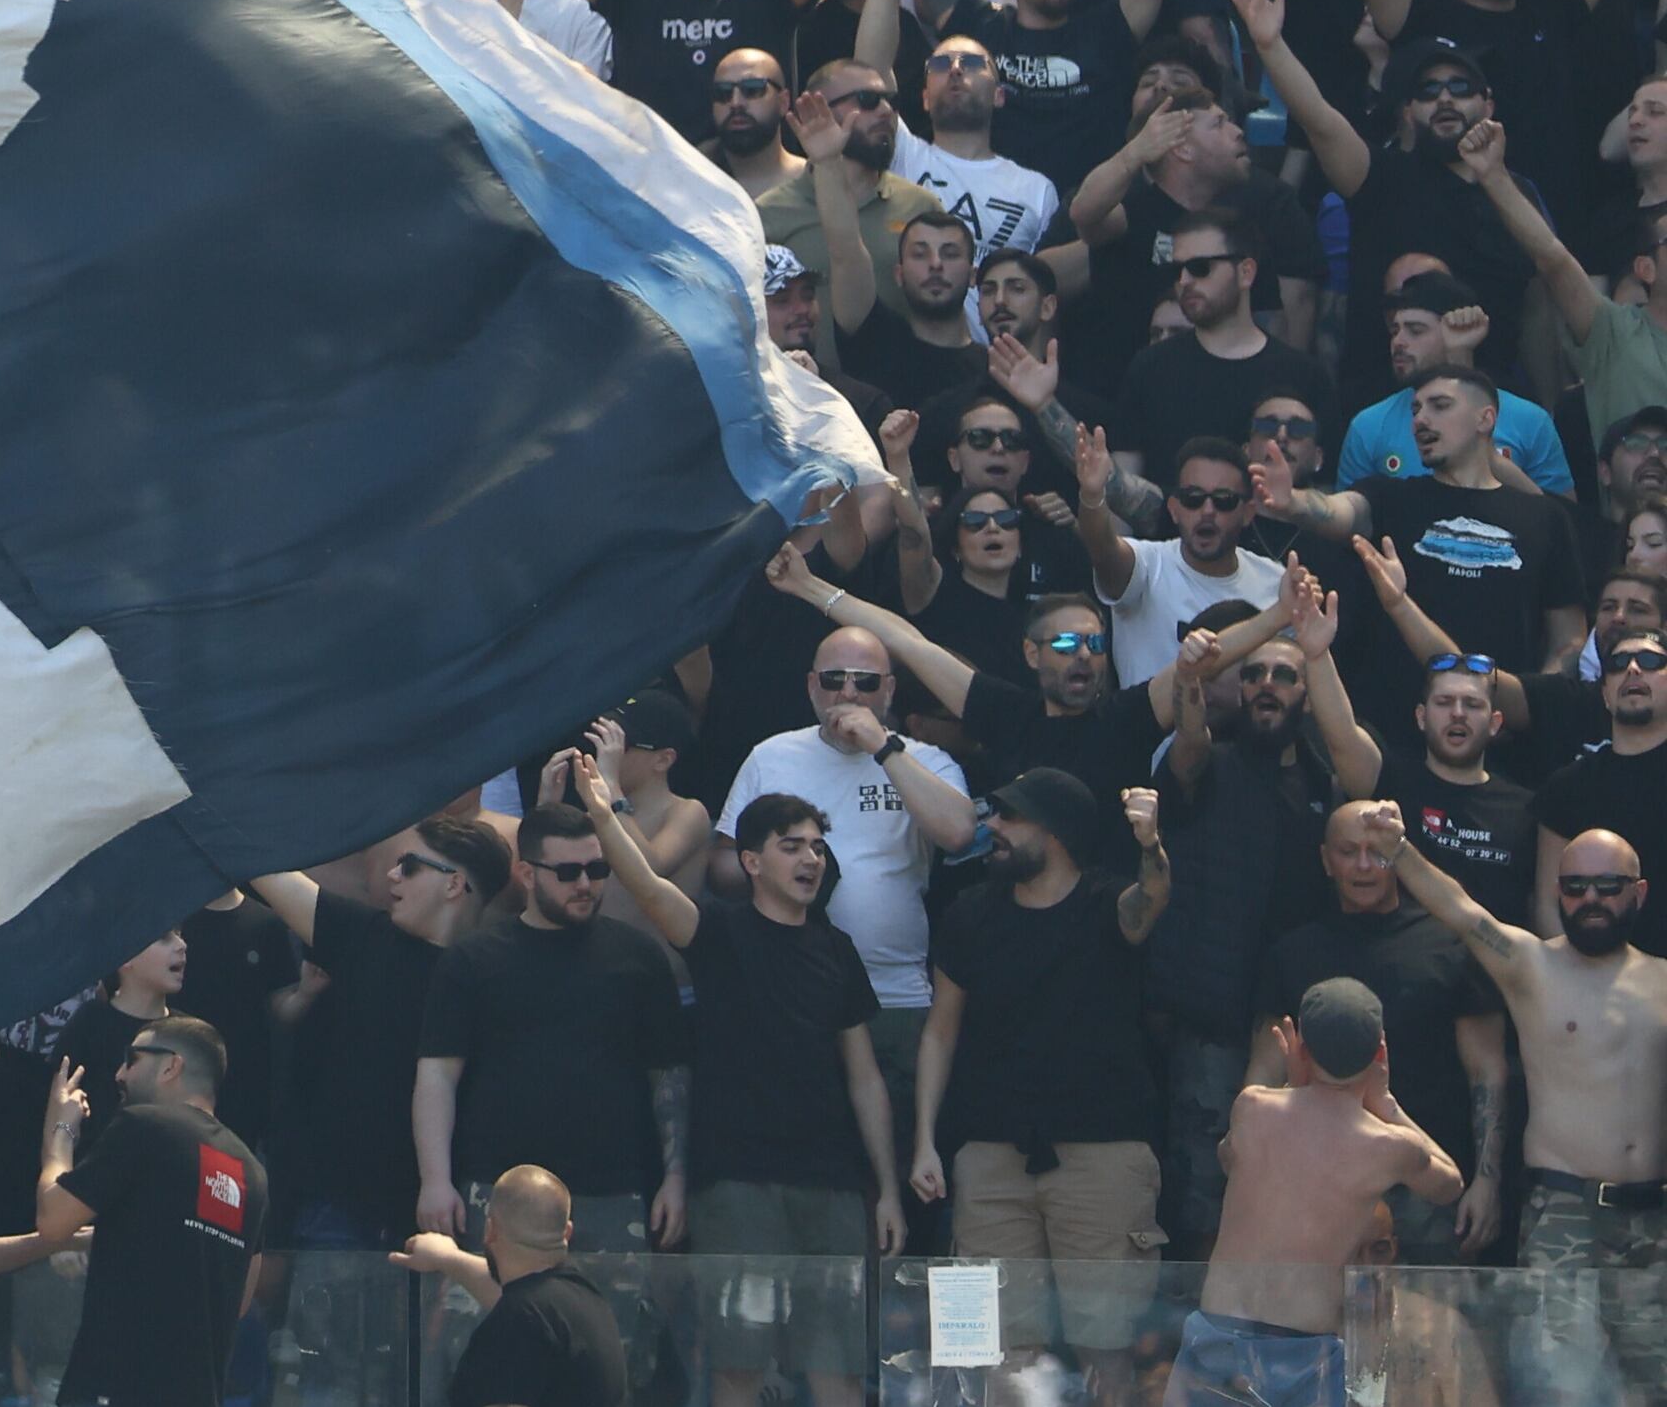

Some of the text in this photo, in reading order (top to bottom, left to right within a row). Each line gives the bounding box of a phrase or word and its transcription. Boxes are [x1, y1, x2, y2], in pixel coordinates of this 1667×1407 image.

[661, 17, 734, 42] merc
[1447, 565, 1483, 579] NAPOLI
[1458, 829, 1492, 843] HOUSE
